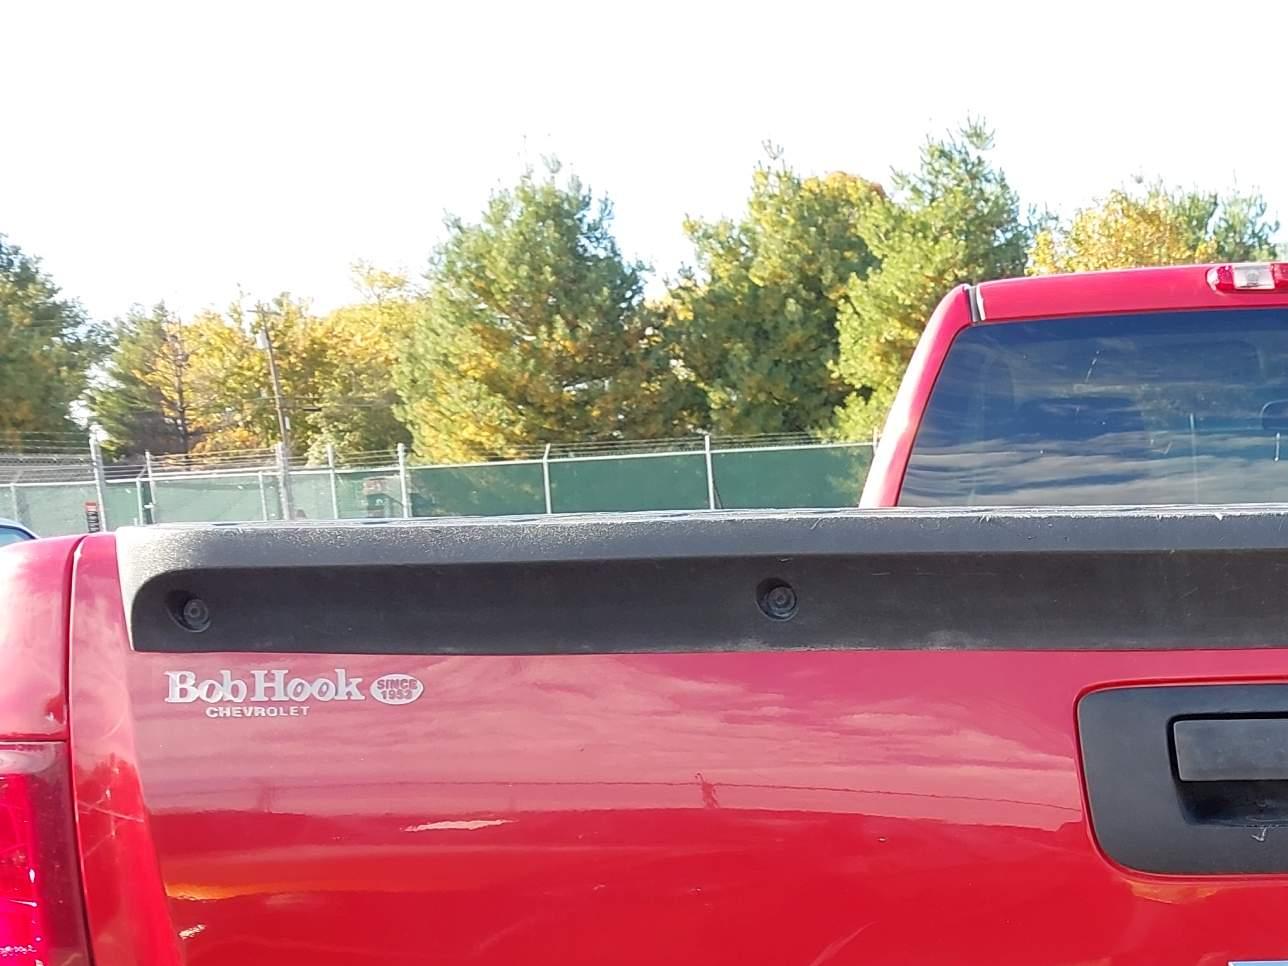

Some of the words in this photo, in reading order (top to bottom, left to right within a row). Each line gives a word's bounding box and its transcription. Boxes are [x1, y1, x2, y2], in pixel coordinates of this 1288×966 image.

[164, 670, 247, 703] Bob
[250, 669, 365, 702] Hook
[376, 679, 418, 690] SINCE
[206, 705, 310, 718] CHEVROLET
